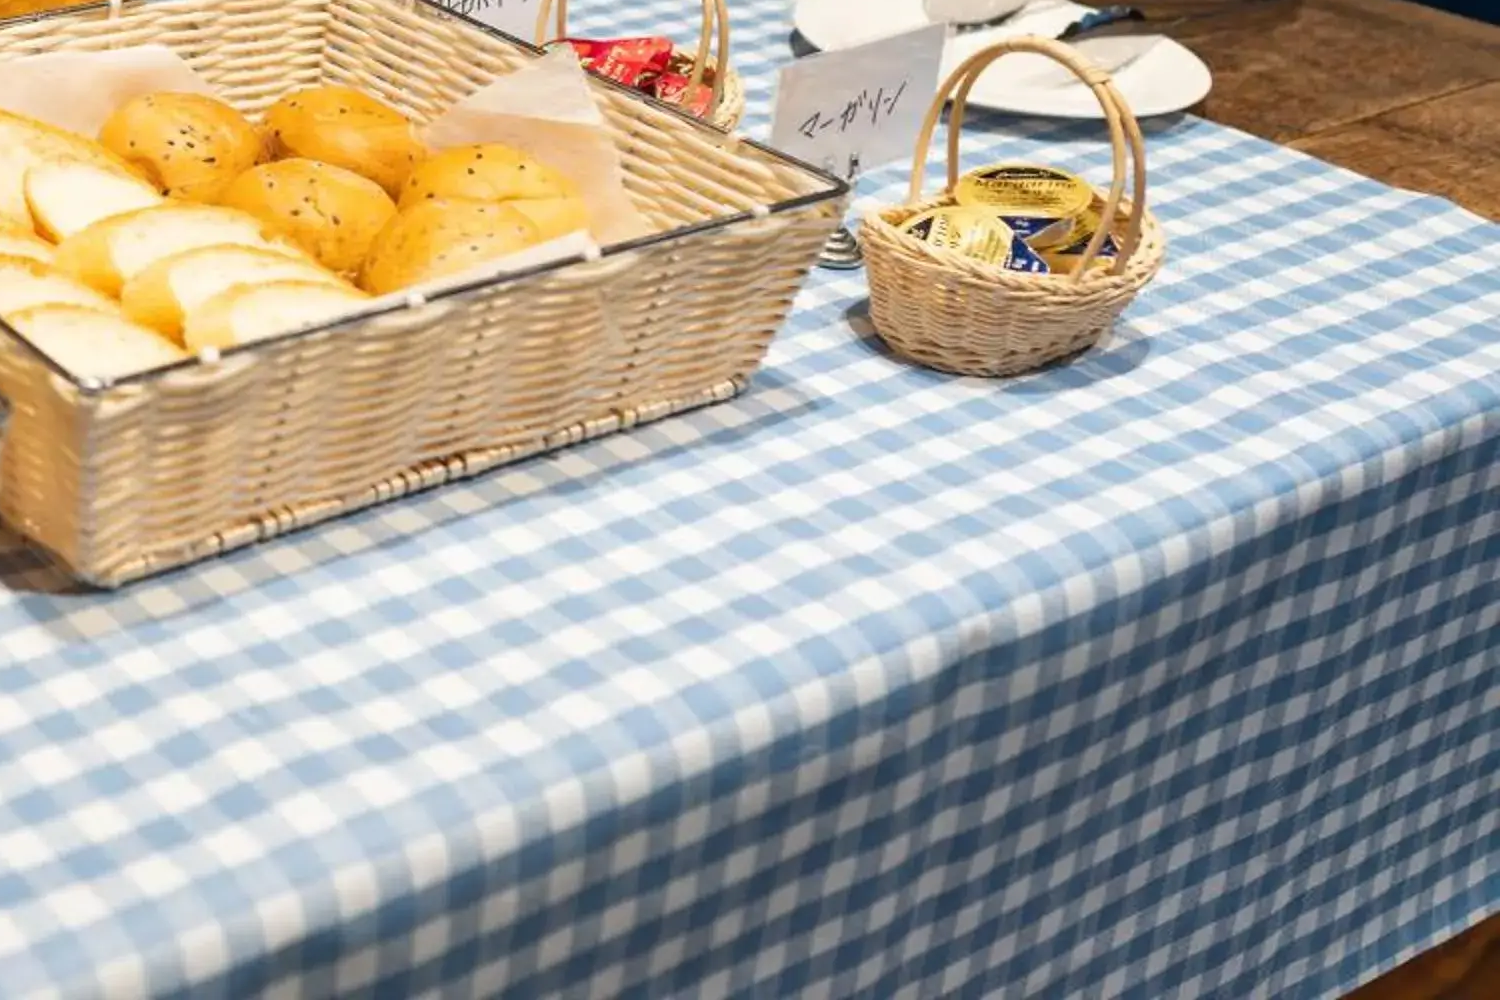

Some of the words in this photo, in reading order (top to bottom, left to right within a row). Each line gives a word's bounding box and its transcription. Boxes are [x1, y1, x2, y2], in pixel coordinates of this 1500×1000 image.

[799, 80, 909, 139] マーガリン
